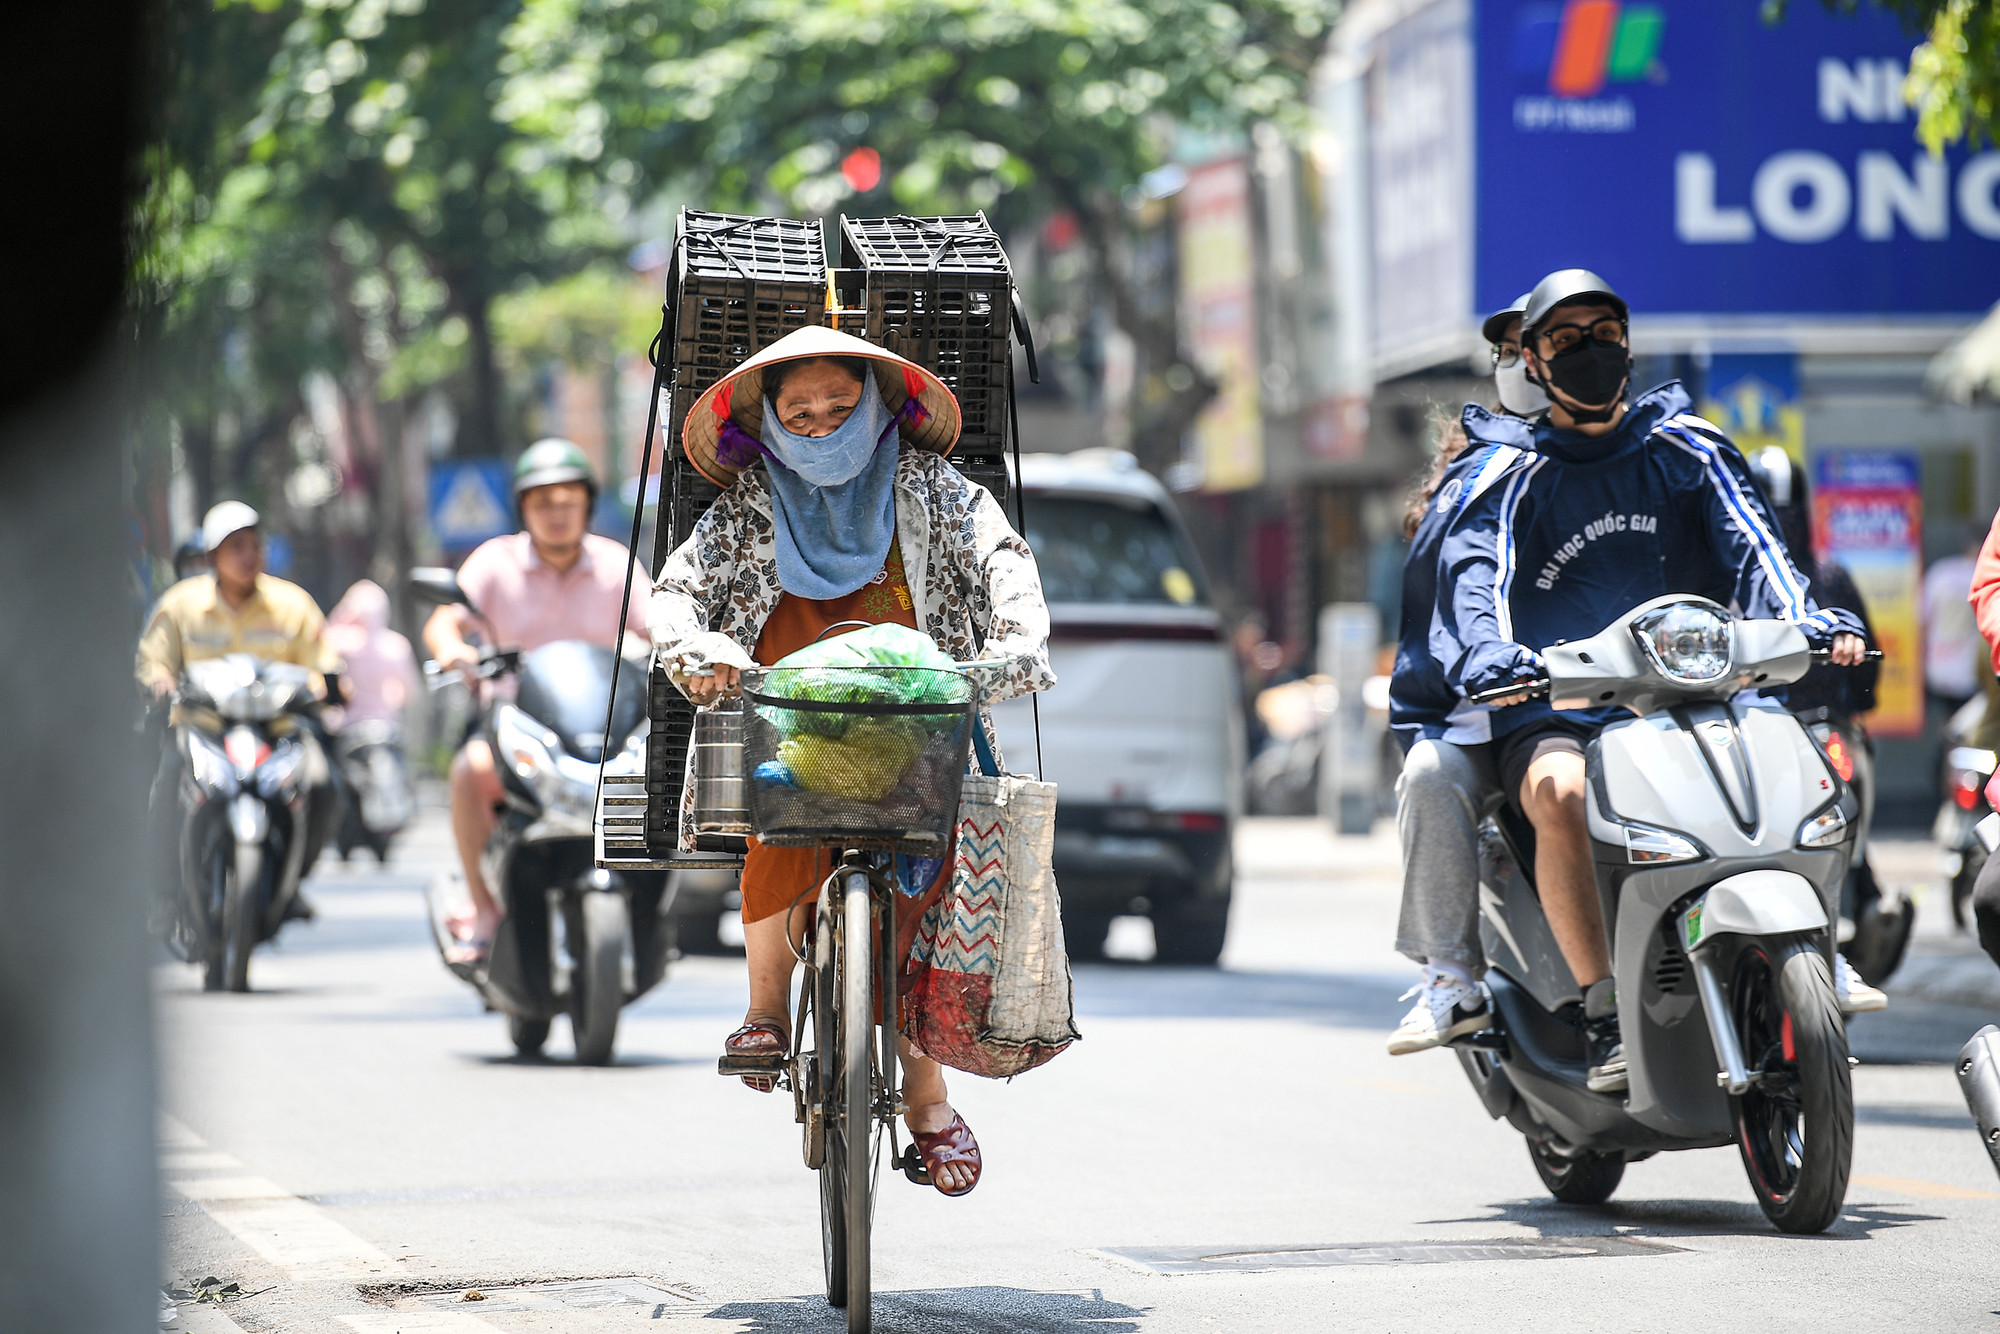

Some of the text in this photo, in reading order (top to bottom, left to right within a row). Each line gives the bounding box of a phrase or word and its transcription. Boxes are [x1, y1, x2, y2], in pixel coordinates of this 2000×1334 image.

[1536, 510, 1657, 590] ĐẠI HỌC QUỐC GIA
